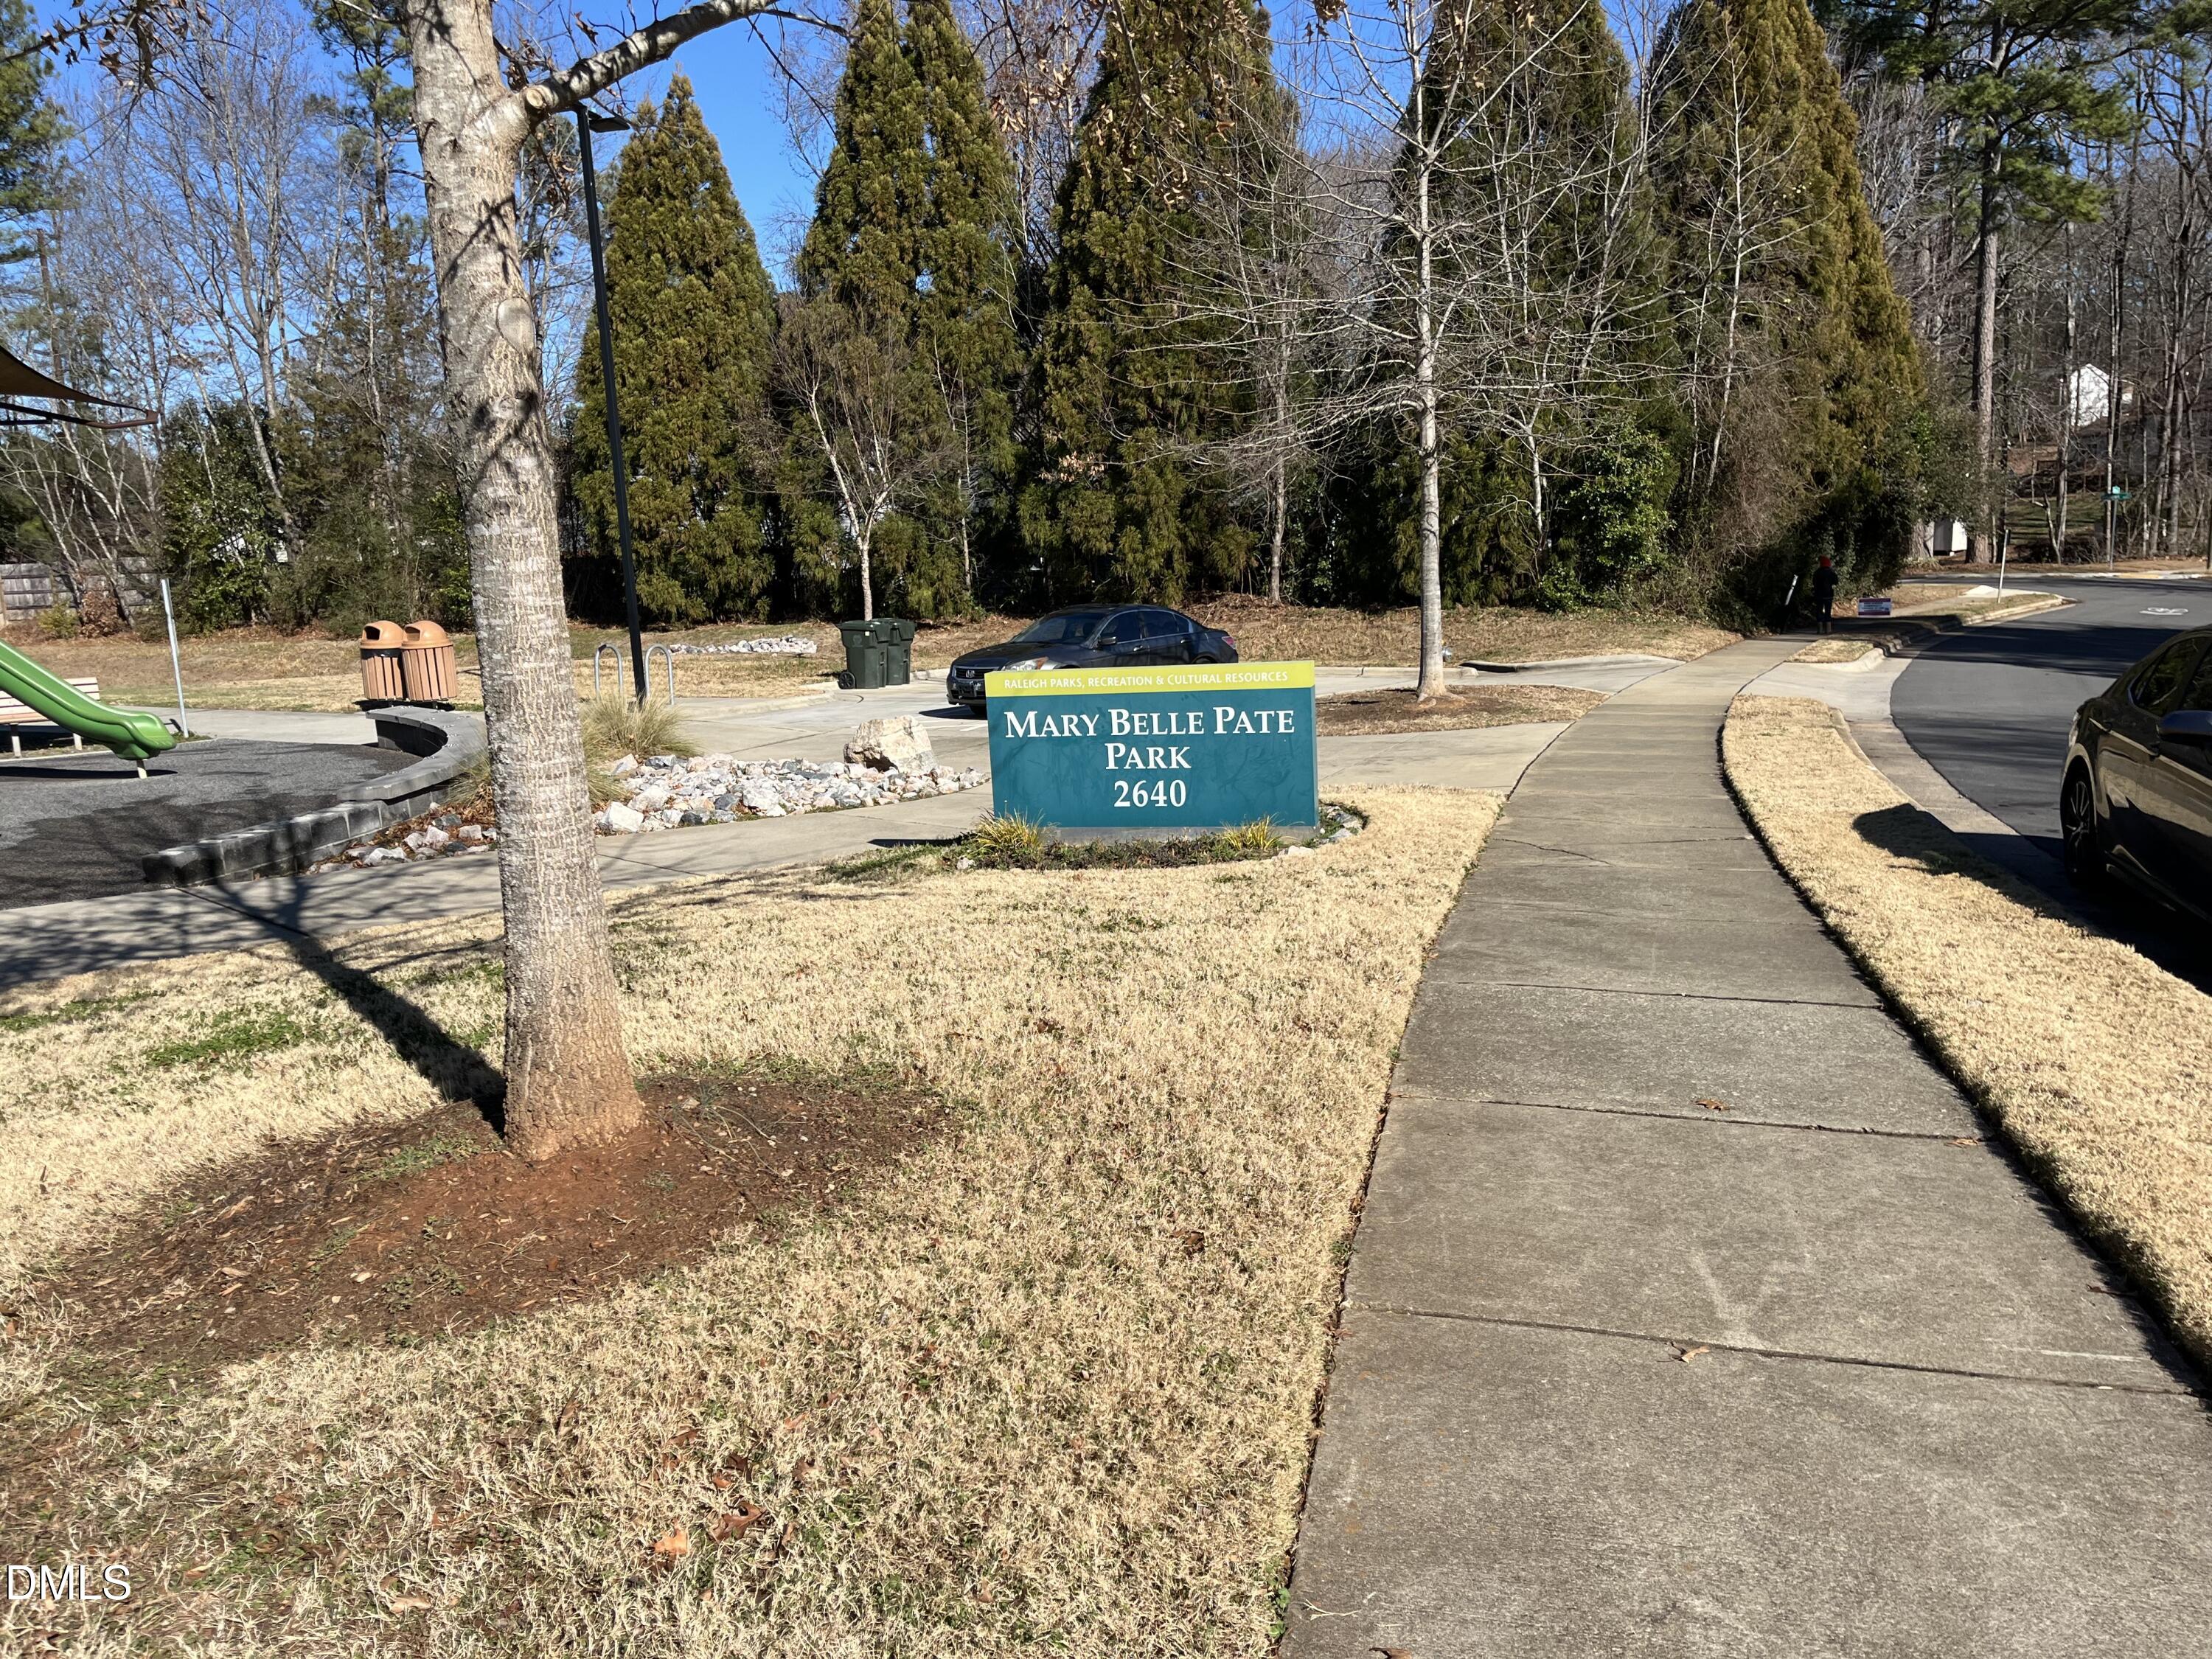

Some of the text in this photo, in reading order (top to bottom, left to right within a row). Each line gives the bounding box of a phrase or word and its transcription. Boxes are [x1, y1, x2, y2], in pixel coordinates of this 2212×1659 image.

[1004, 672, 1288, 689] RALEIGH PARKS, RECREATION & CULTURAL RESOURCES
[1004, 706, 1295, 738] MARY BELLE PATE
[1105, 742, 1192, 770] PARK
[1114, 779, 1186, 807] 2640
